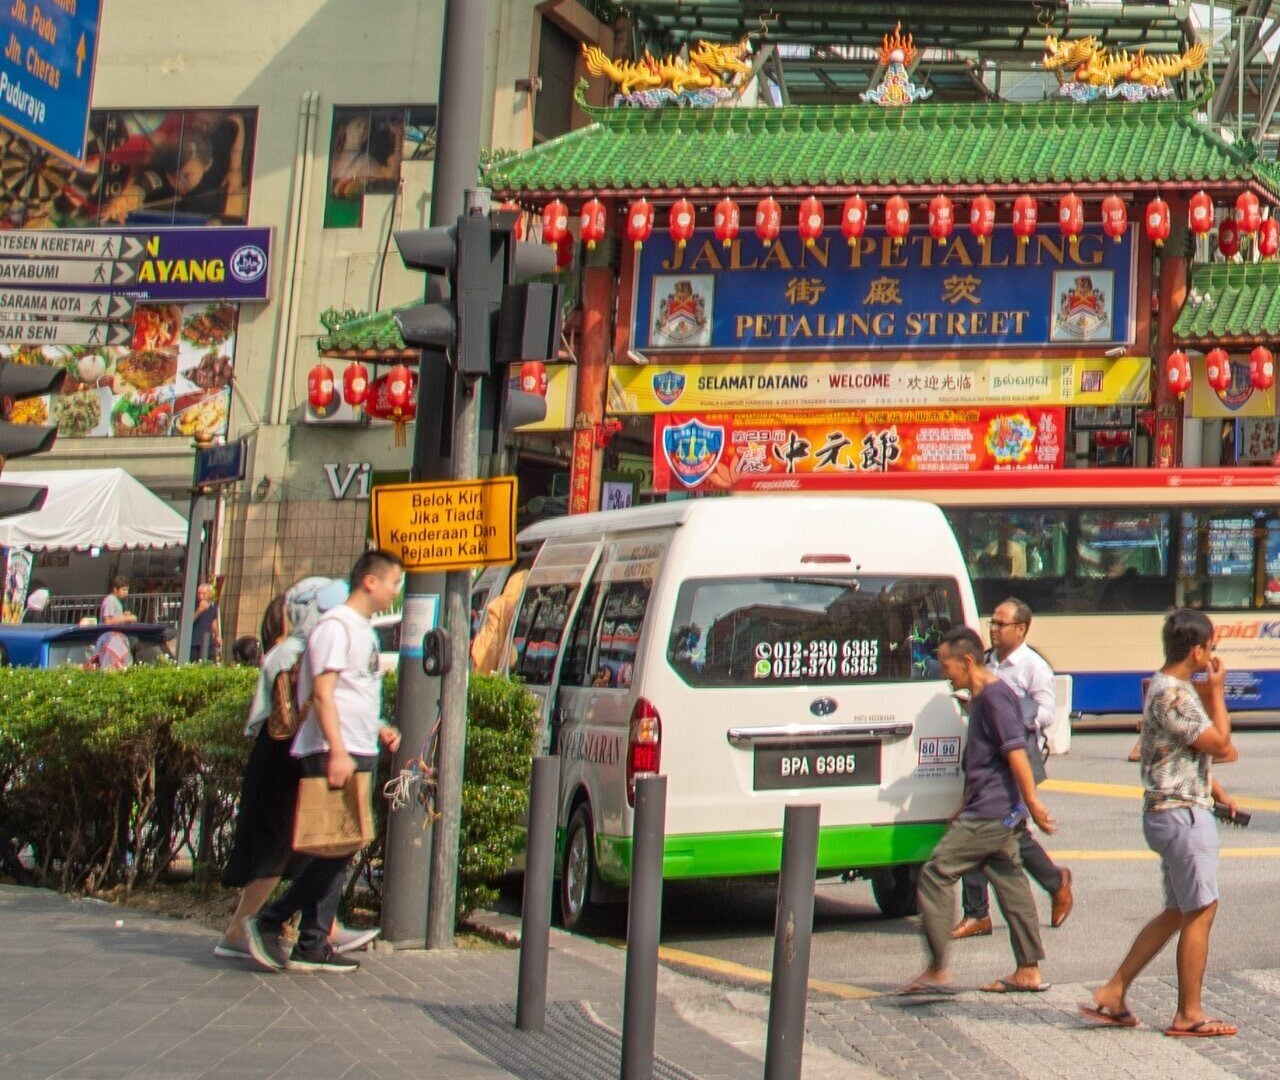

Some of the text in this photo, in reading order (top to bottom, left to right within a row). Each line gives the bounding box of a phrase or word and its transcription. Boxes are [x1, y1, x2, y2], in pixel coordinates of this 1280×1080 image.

[31, 11, 57, 46] Pudu
[4, 33, 61, 91] Jln. Cheras
[0, 72, 47, 124] Puduraya
[41, 237, 95, 253] KERETAPI
[661, 232, 1105, 273] JALAN PETALING
[51, 295, 82, 312] KOTA
[27, 325, 58, 340] SENI
[735, 310, 1031, 339] PETALING STREET
[697, 373, 891, 390] SELAMAT DATANG WELCOME
[906, 372, 973, 392] 欢迎光临
[412, 493, 453, 508] Belok
[410, 506, 484, 525] Jika Tiada
[390, 523, 497, 544] Kenderaan Dan
[400, 542, 489, 563] Pejalan Kaki
[773, 639, 879, 659] 012-230 6385
[772, 656, 878, 678] 012-370 6385
[922, 742, 935, 754] 80
[942, 744, 955, 754] 90
[781, 754, 856, 777] BPA 6385
